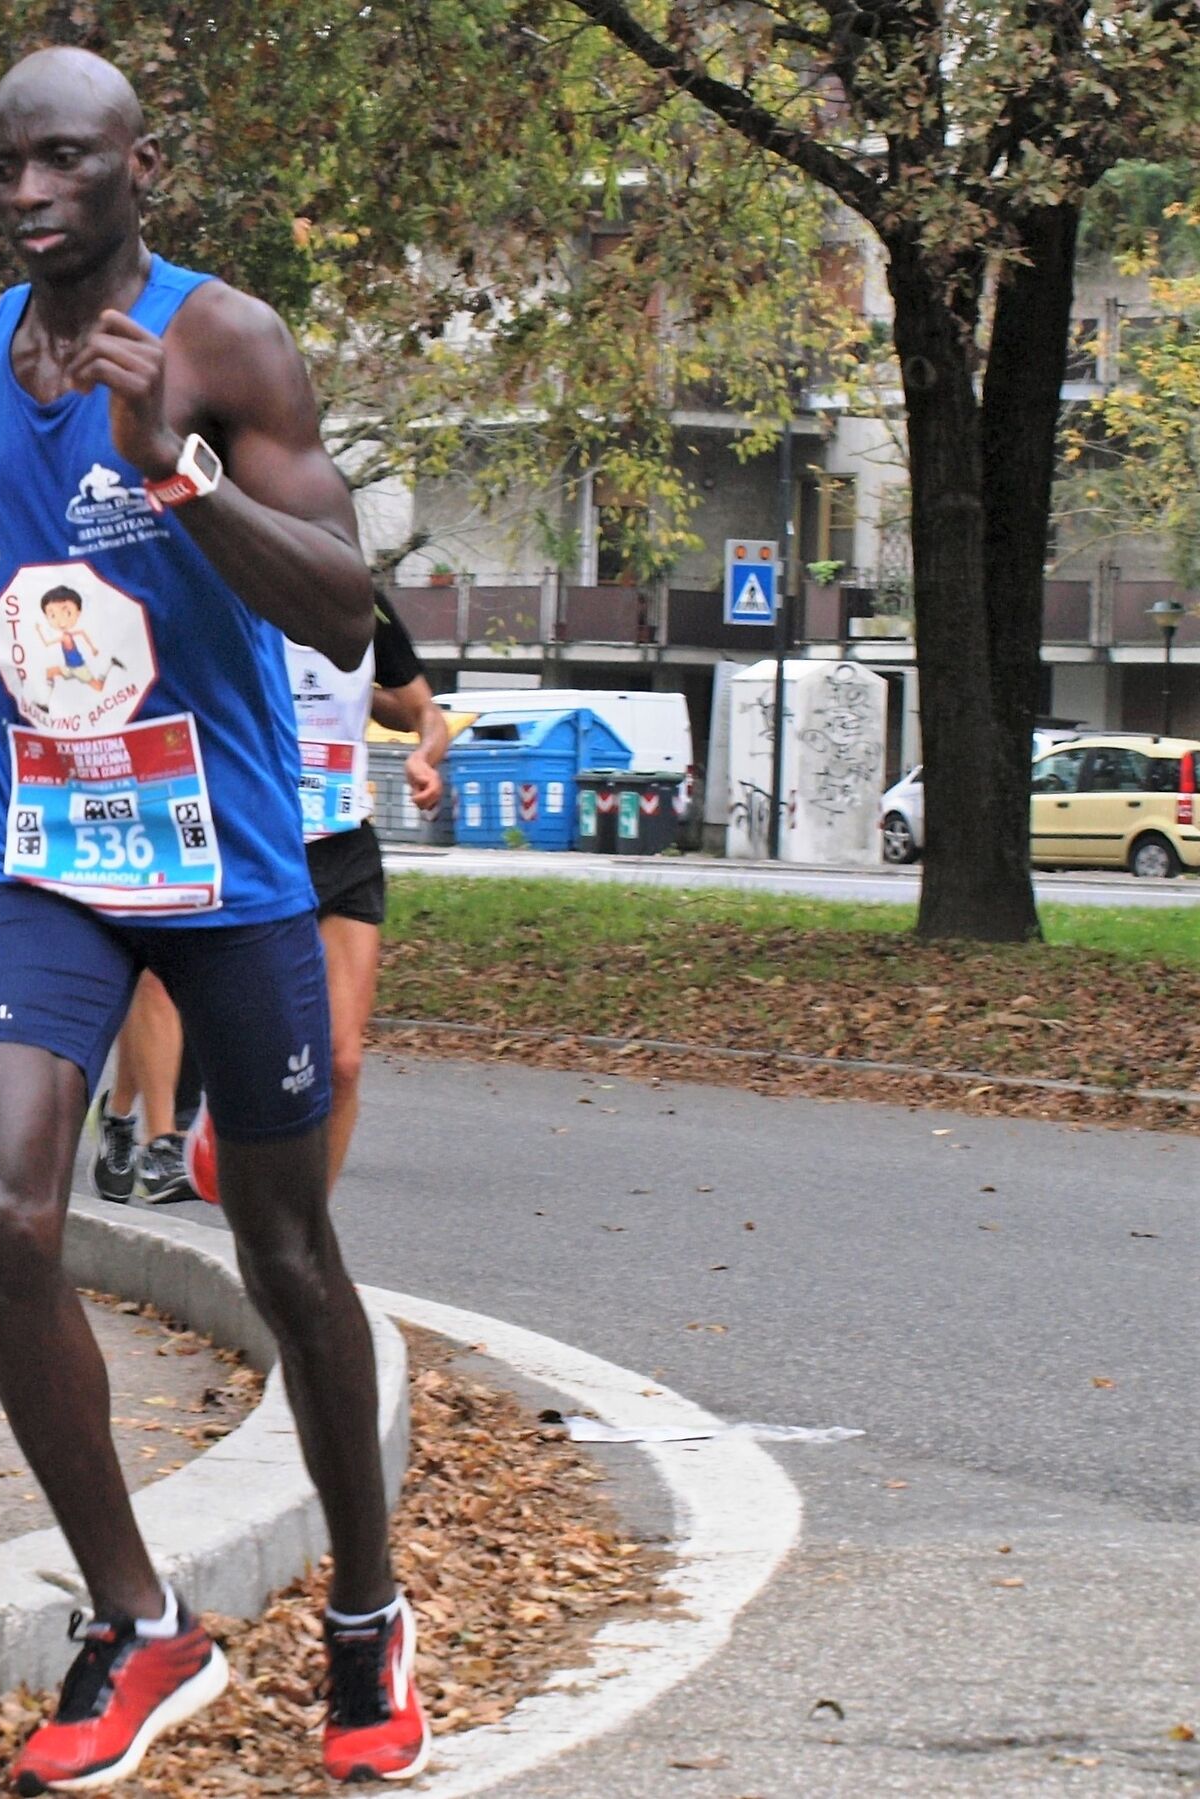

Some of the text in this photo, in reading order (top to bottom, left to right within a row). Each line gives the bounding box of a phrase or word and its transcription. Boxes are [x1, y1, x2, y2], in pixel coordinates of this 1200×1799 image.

[5, 595, 27, 688] STOP
[20, 683, 139, 732] BULLYING RACISM
[73, 825, 155, 869] 536
[60, 870, 141, 884] MAMADOU
